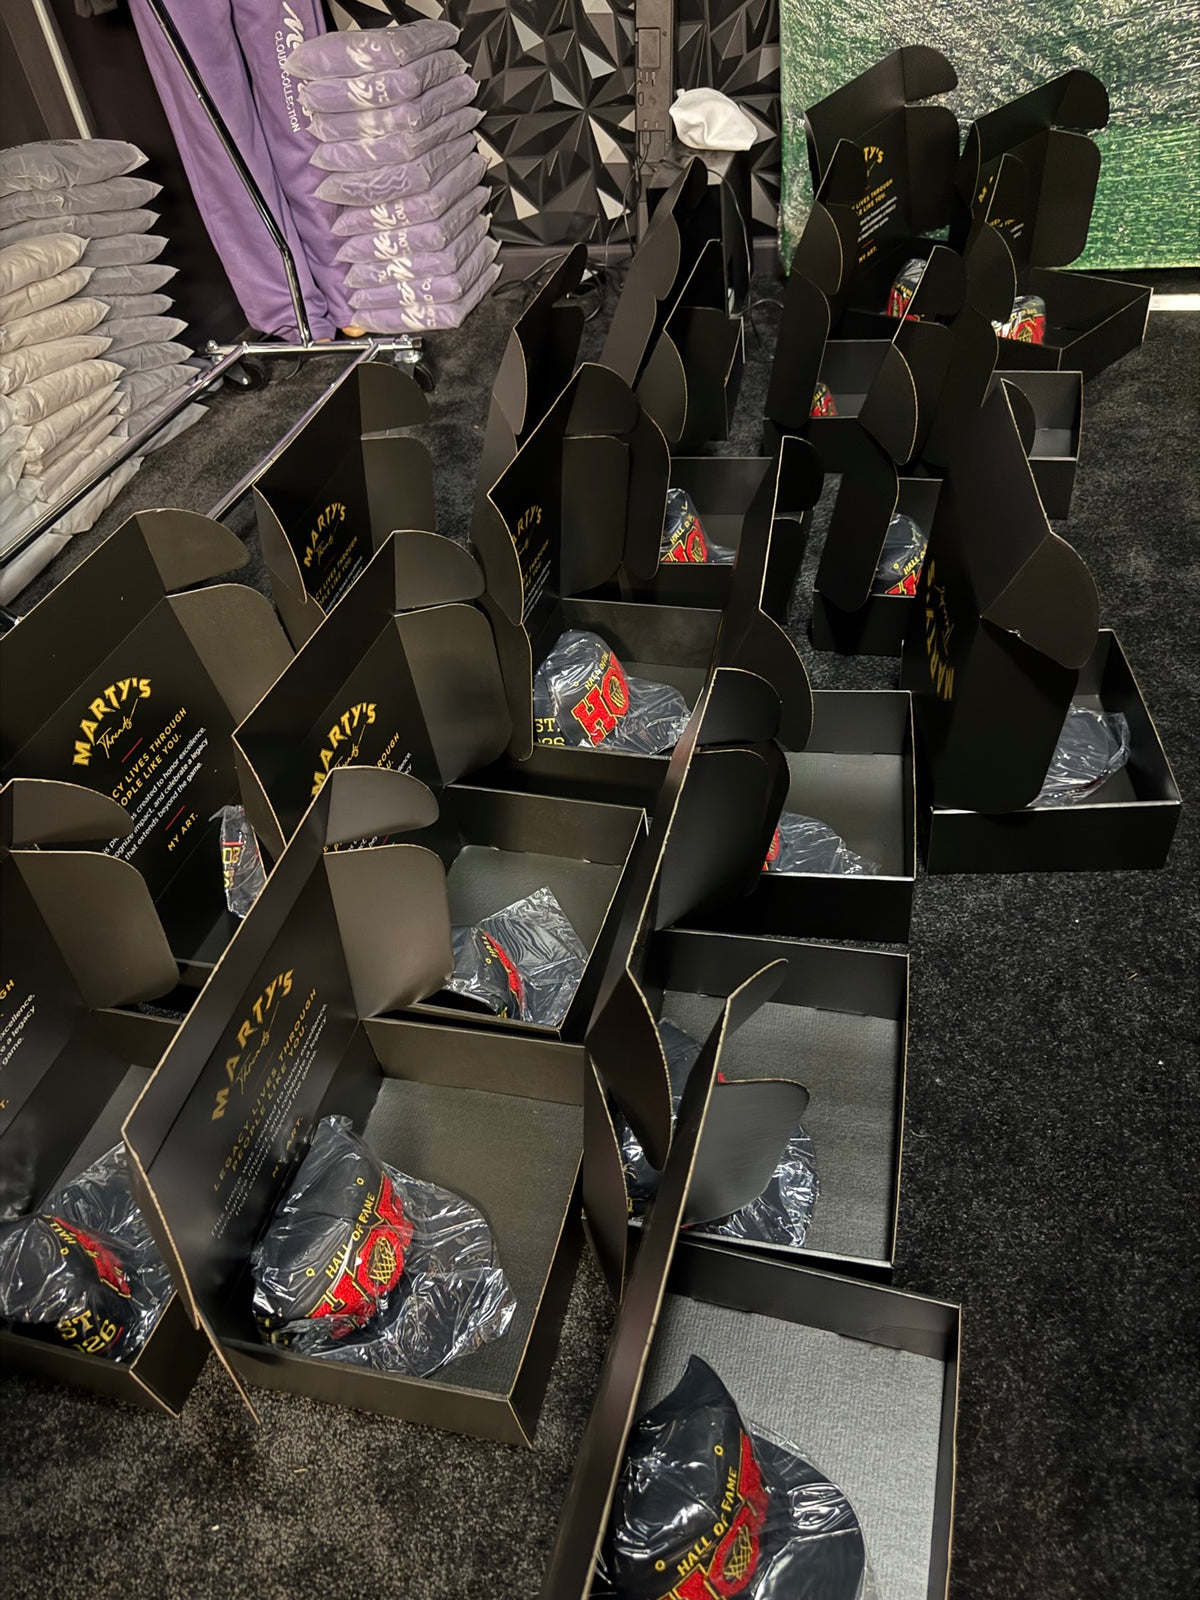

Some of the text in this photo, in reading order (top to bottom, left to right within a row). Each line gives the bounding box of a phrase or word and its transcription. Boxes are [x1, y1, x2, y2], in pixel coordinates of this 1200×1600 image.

[281, 70, 300, 133] COLLECTION
[864, 146, 884, 164] TY'S
[304, 502, 346, 568] MARTY'S
[903, 556, 920, 575] HALL
[72, 677, 152, 766] MARTY'S
[125, 707, 187, 783] LIVES THROUGH
[310, 702, 376, 797] MARTY'S
[377, 732, 400, 768] ROUGH
[534, 718, 560, 733] ST.
[114, 833, 134, 858] ognize
[154, 792, 165, 808] and
[164, 764, 189, 794] celebrate
[190, 738, 208, 761] legacy
[120, 734, 182, 806] OPLE LIKE YOU.
[136, 786, 158, 813] created
[156, 778, 164, 788] to
[162, 759, 180, 780] honor
[178, 727, 206, 760] excellence.
[124, 762, 203, 861] that extends beyond the game.
[167, 812, 200, 852] MY ART.
[2, 1038, 24, 1066] game.
[12, 1006, 35, 1037] legacy
[212, 968, 294, 1121] MARTY'S
[214, 988, 317, 1192] LEGACY LIVES THROUGH
[232, 1024, 308, 1172] PEOPLE LIKE YOU.
[326, 1192, 376, 1279] HALL OF FAME
[57, 1309, 100, 1340] ST.
[72, 1319, 116, 1354] 26
[677, 1466, 739, 1576] HALL OF FAME
